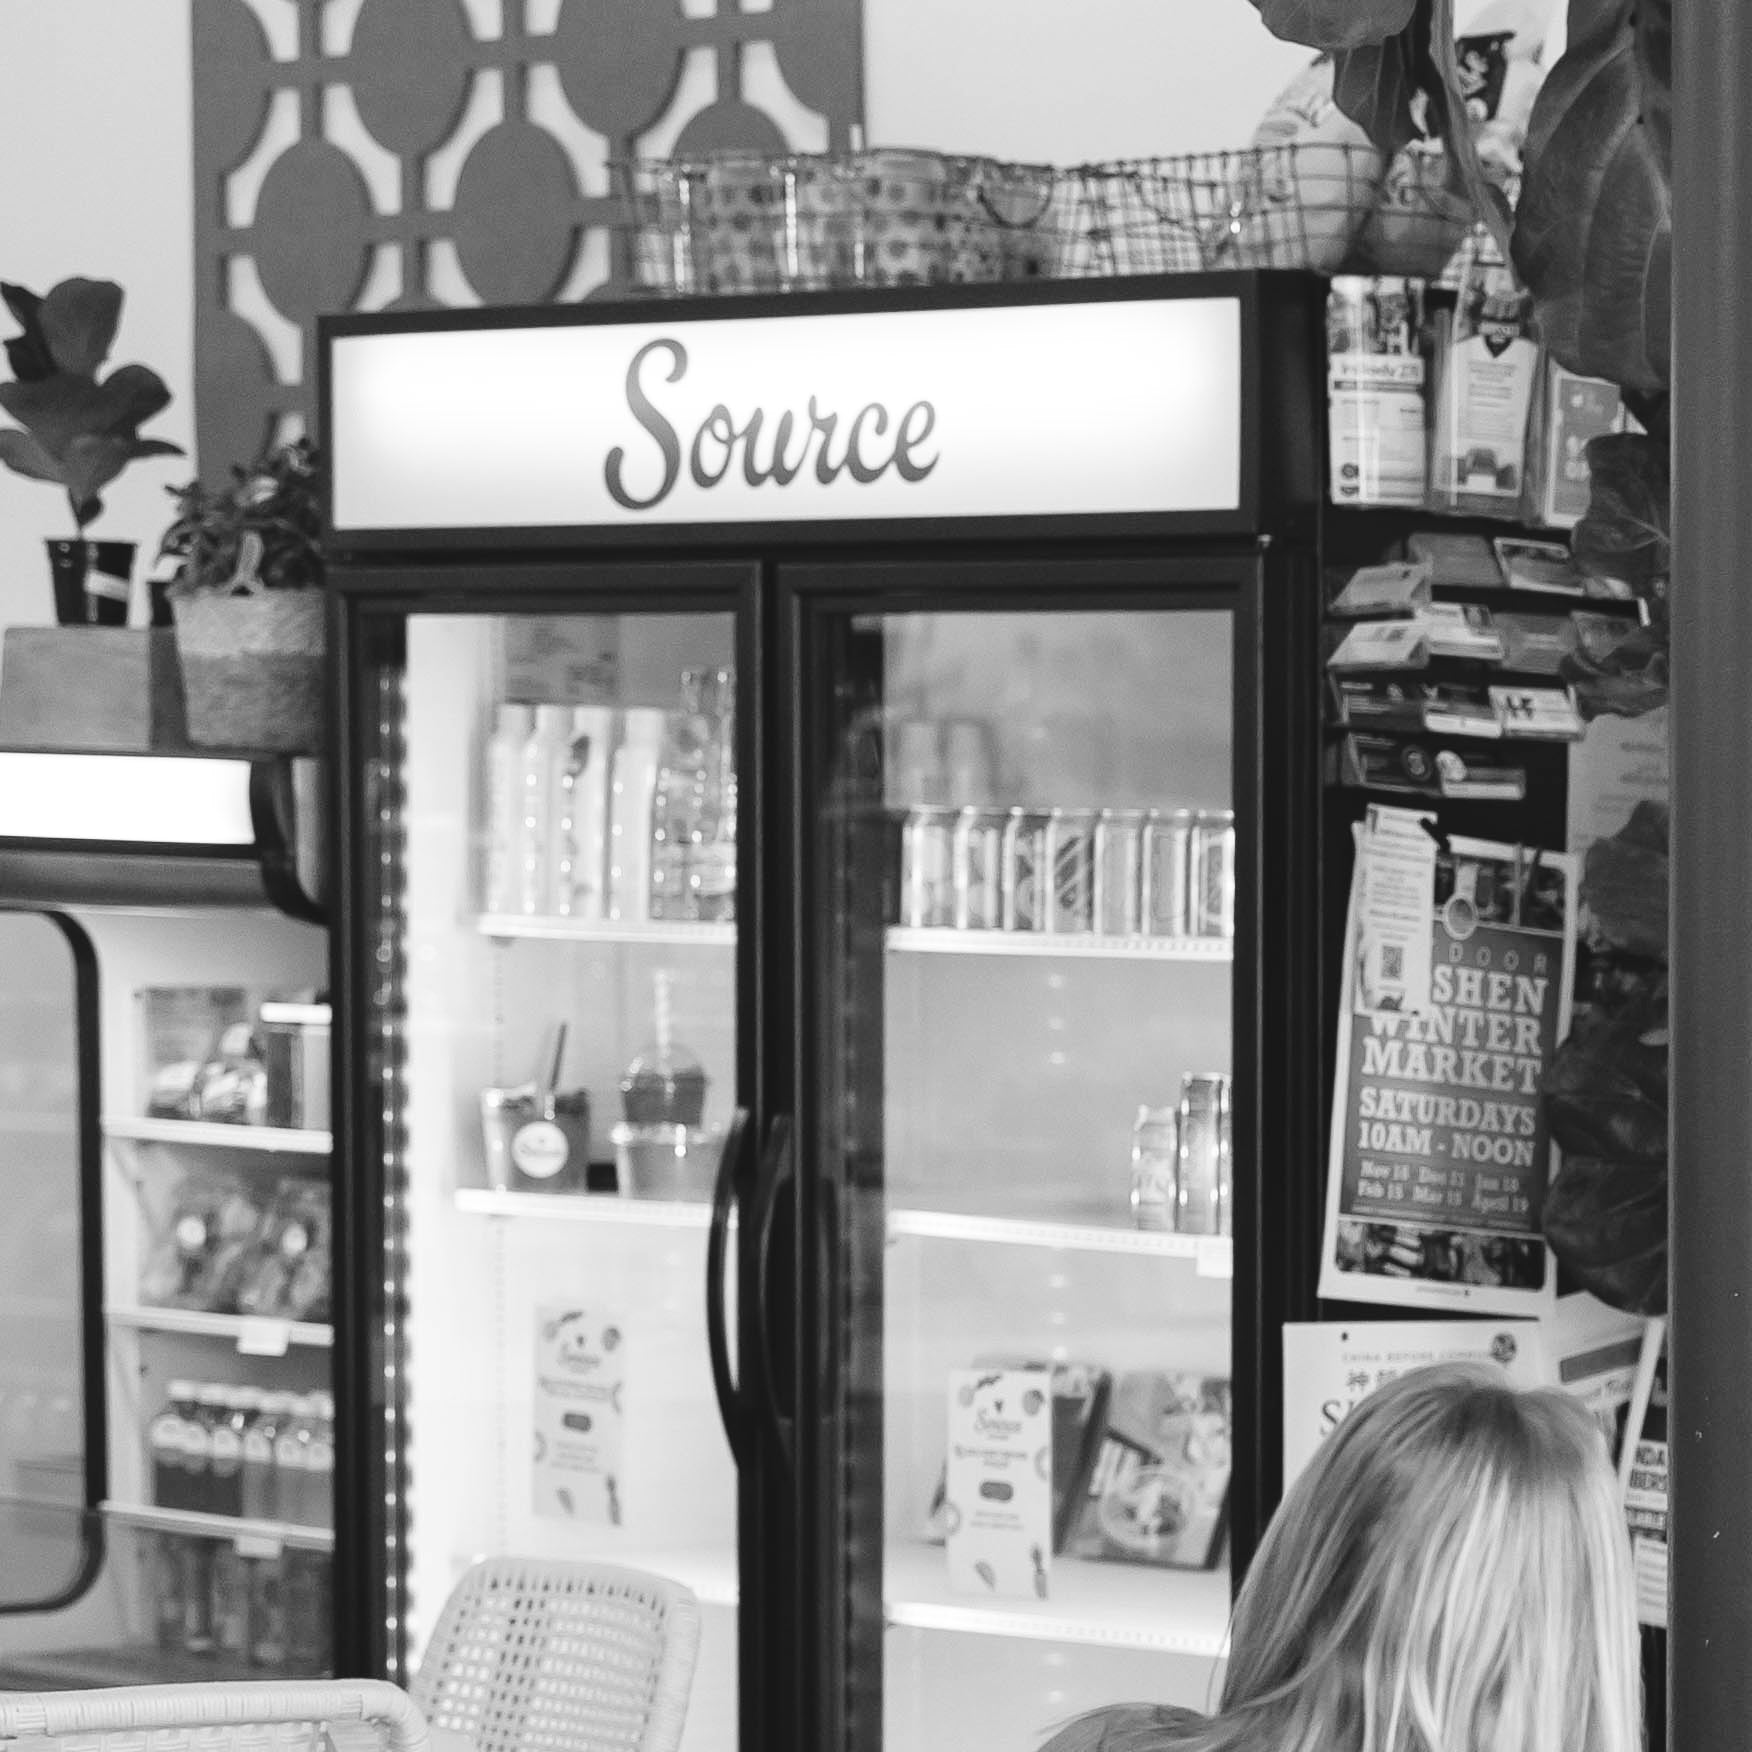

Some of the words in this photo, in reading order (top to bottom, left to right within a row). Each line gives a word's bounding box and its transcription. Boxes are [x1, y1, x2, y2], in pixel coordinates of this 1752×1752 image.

[603, 337, 941, 510] Source
[1449, 942, 1547, 974] DOOR
[1433, 963, 1549, 1016] SHEN
[1370, 1003, 1543, 1056] WINTER
[1361, 1035, 1542, 1094] MARKET
[1358, 1086, 1536, 1136] SATURDAYS
[1358, 1119, 1432, 1156] 10AM
[1451, 1132, 1536, 1167] NOON
